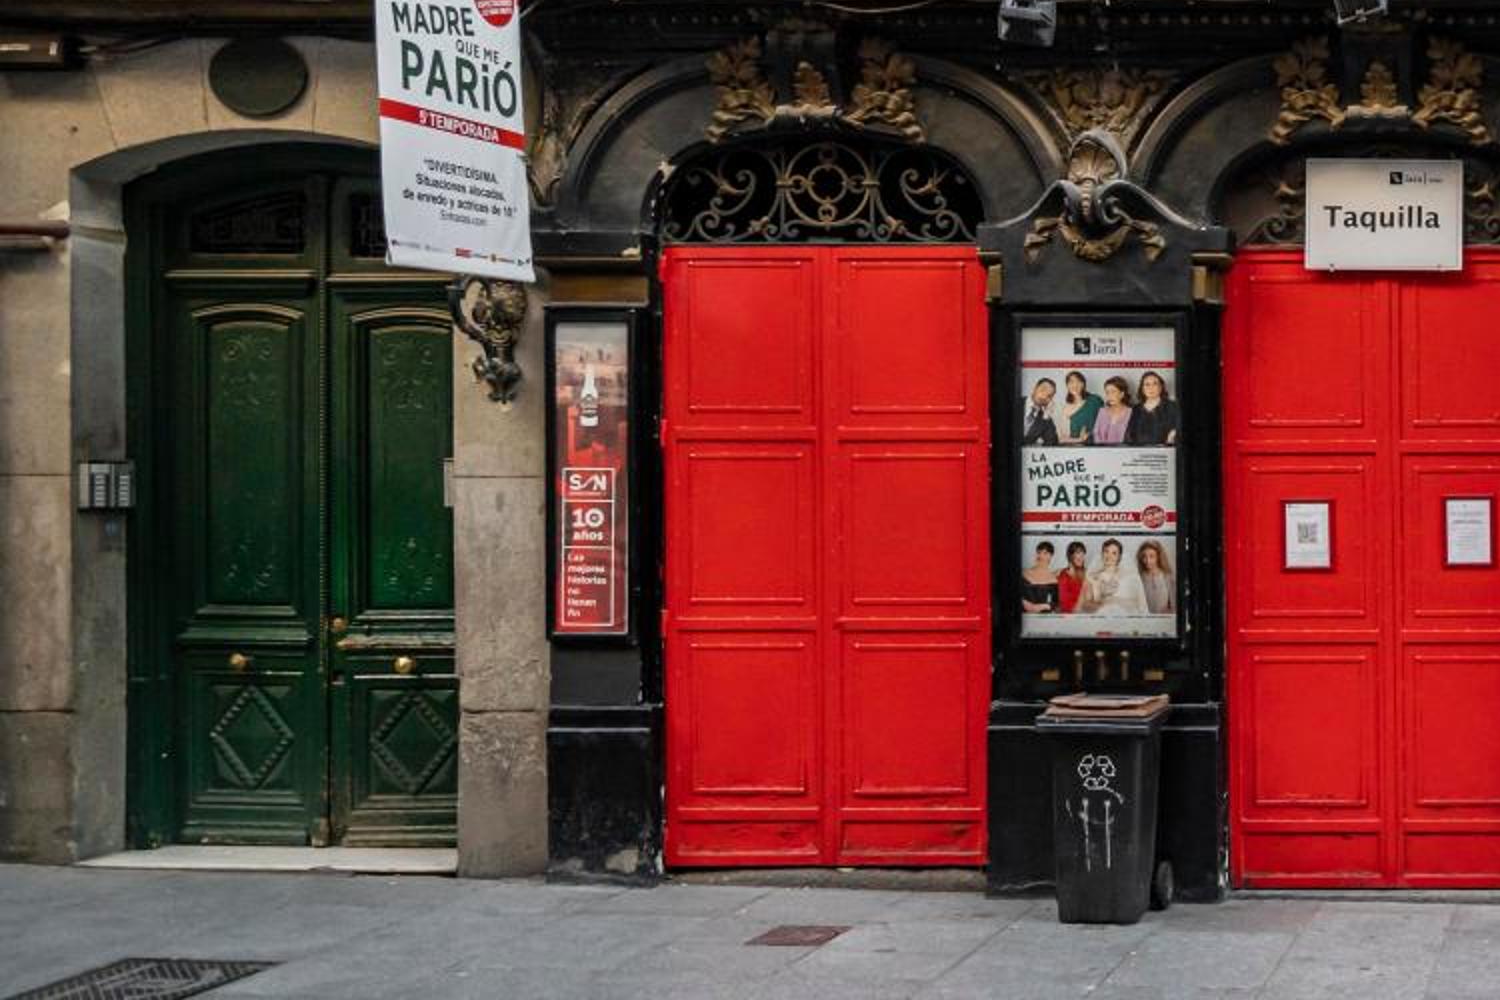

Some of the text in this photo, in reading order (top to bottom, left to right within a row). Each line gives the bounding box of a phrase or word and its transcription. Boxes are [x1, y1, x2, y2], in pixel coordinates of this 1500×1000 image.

[391, 1, 475, 37] MADRE
[455, 39, 500, 66] QUE ME
[429, 112, 500, 143] TEMPORADA
[416, 173, 466, 193] Situaciones
[403, 188, 414, 200] de
[417, 191, 448, 206] enredo
[457, 200, 489, 214] actrices
[491, 204, 501, 216] de
[1323, 205, 1441, 233] Taquilla
[1028, 457, 1087, 481] MADRE
[1031, 453, 1047, 463] LA
[572, 507, 605, 528] 10
[573, 530, 603, 541] años
[568, 575, 607, 584] historias
